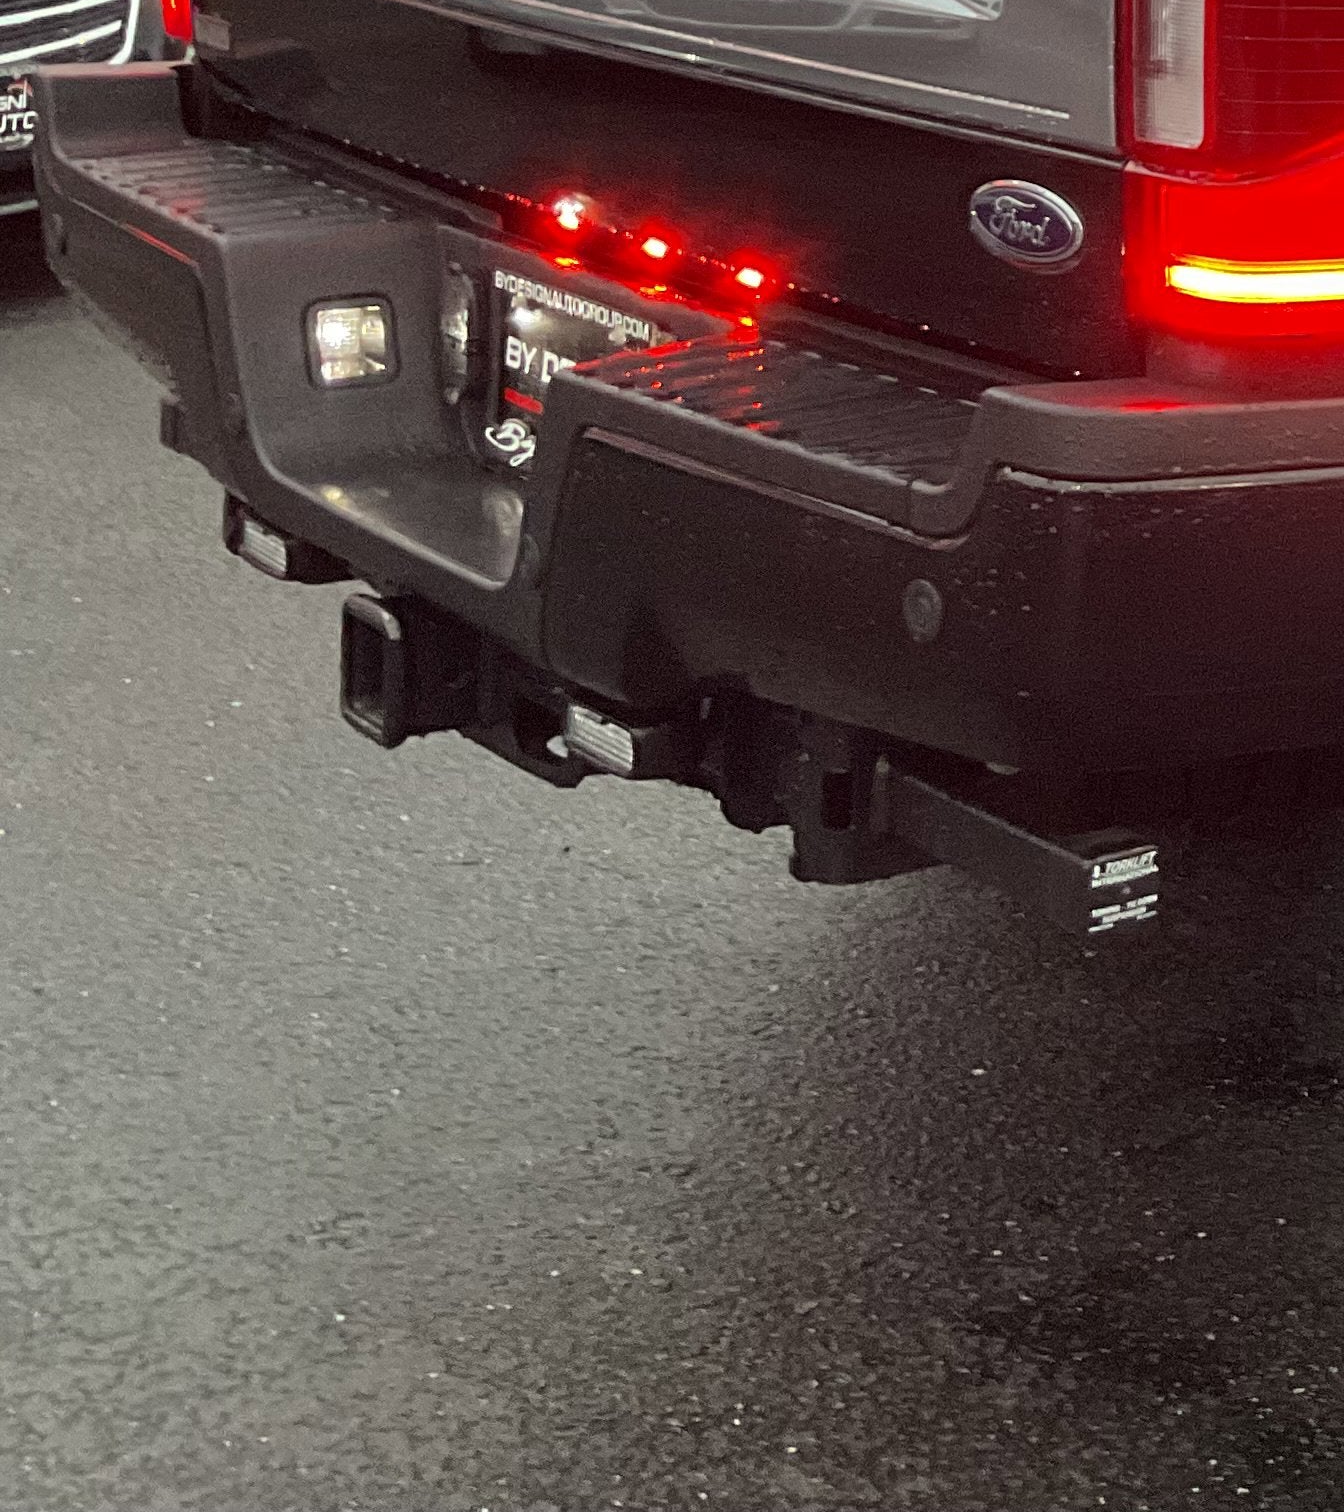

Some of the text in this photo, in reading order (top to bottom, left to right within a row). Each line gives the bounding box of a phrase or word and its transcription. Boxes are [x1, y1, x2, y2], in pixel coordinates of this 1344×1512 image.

[989, 195, 1051, 247] Ford
[495, 270, 649, 341] BYDESIGNAUTOGROUP.COM
[506, 335, 537, 374] BY
